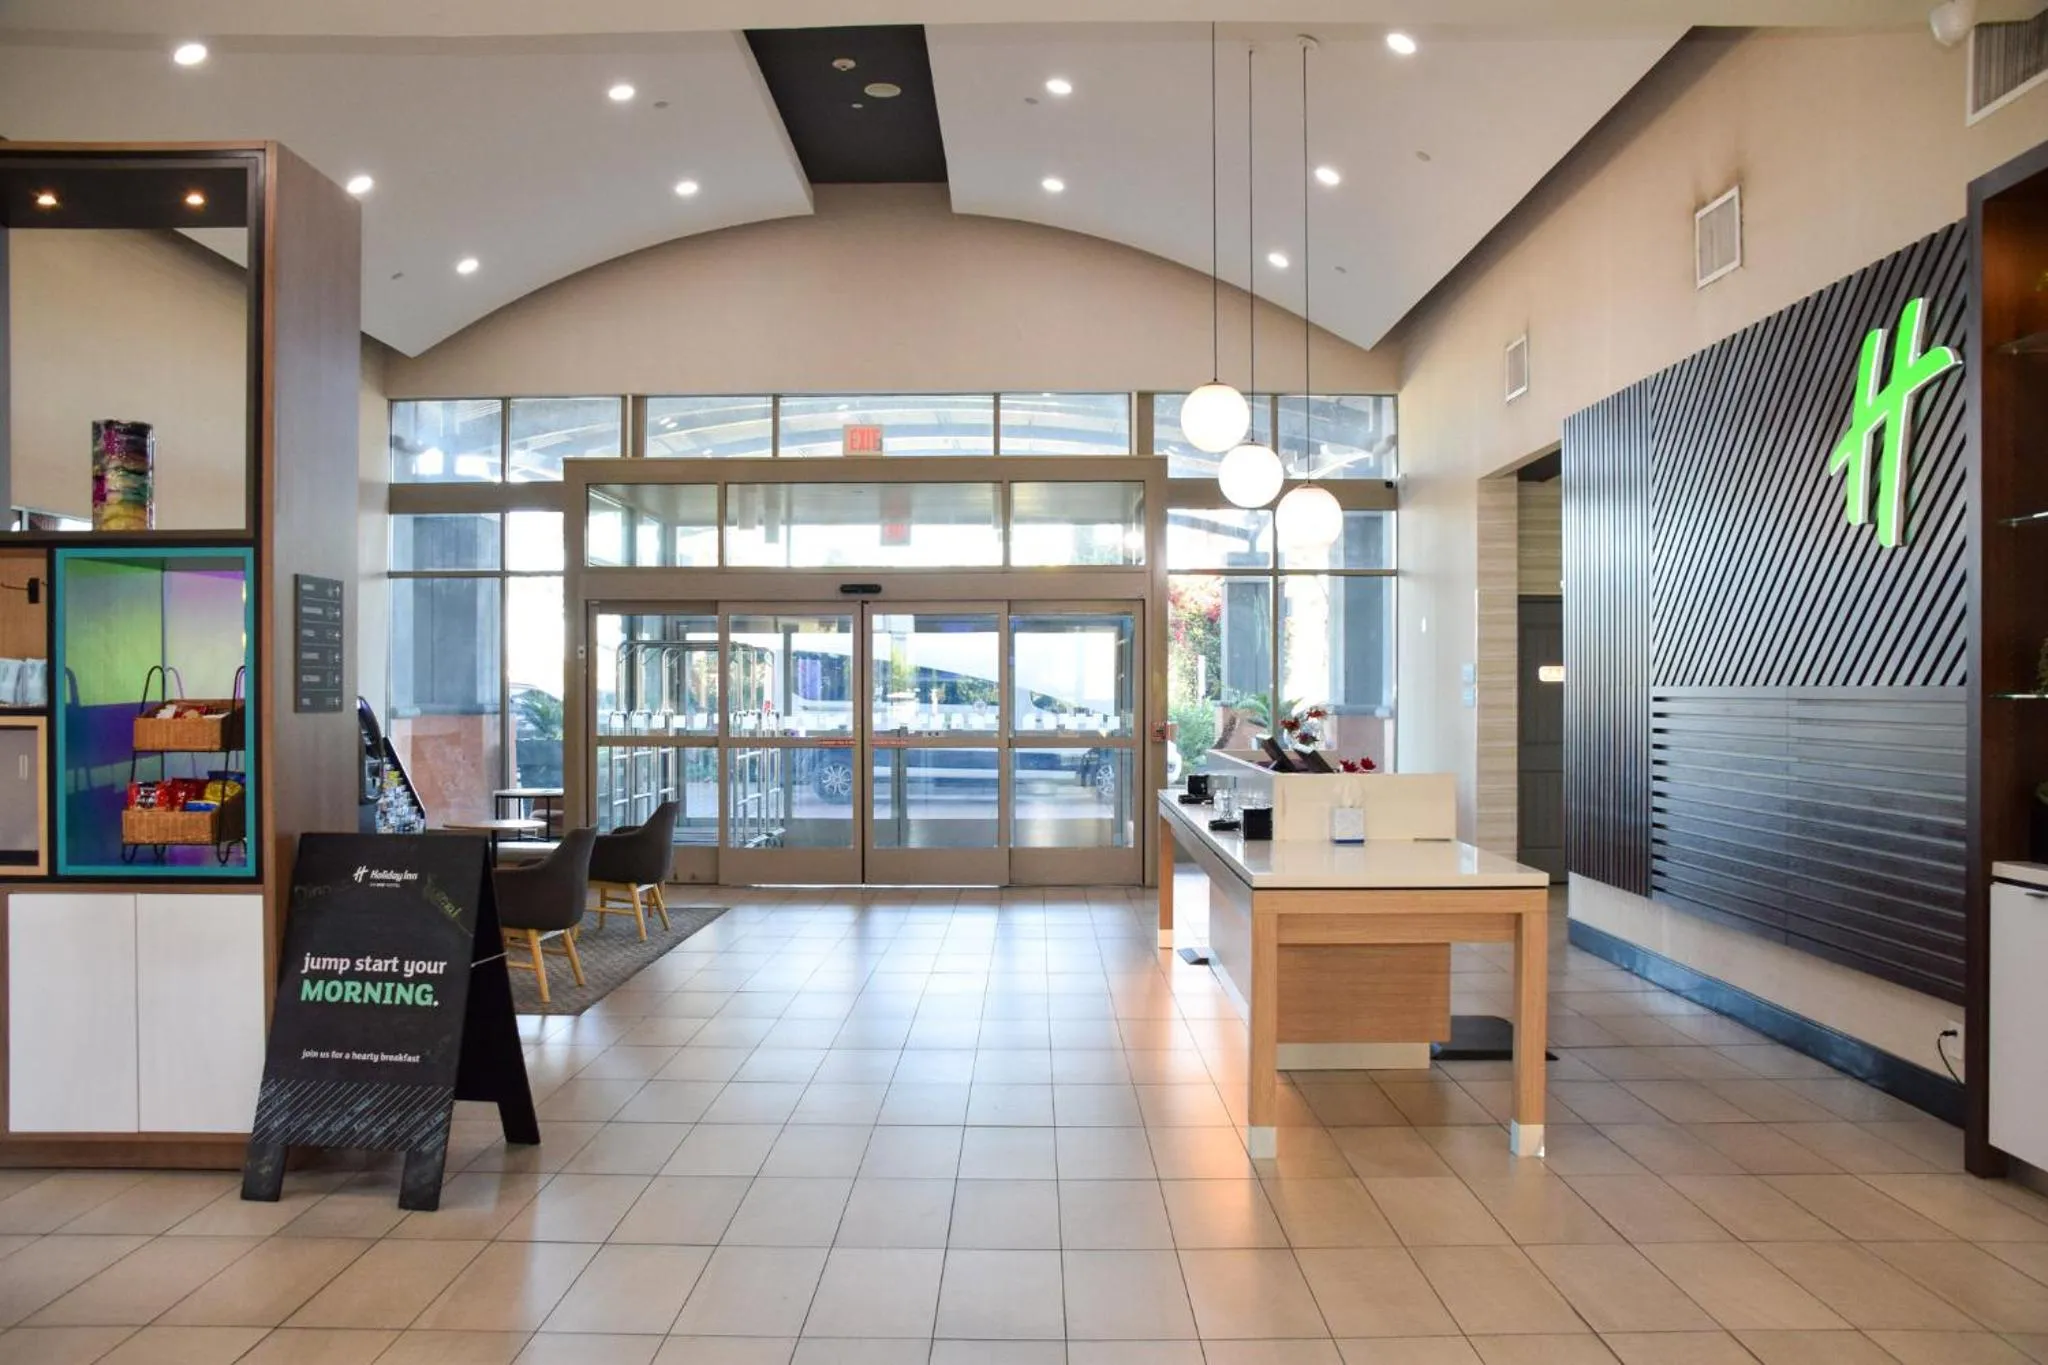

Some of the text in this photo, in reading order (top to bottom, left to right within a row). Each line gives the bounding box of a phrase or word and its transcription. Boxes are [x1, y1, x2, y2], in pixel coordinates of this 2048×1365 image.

[370, 869, 402, 883] Holiday
[403, 870, 419, 881] Inn
[300, 952, 448, 978] jump start your
[300, 978, 440, 1008] MORNING.
[301, 1049, 421, 1064] join us for a hearty breakfast
